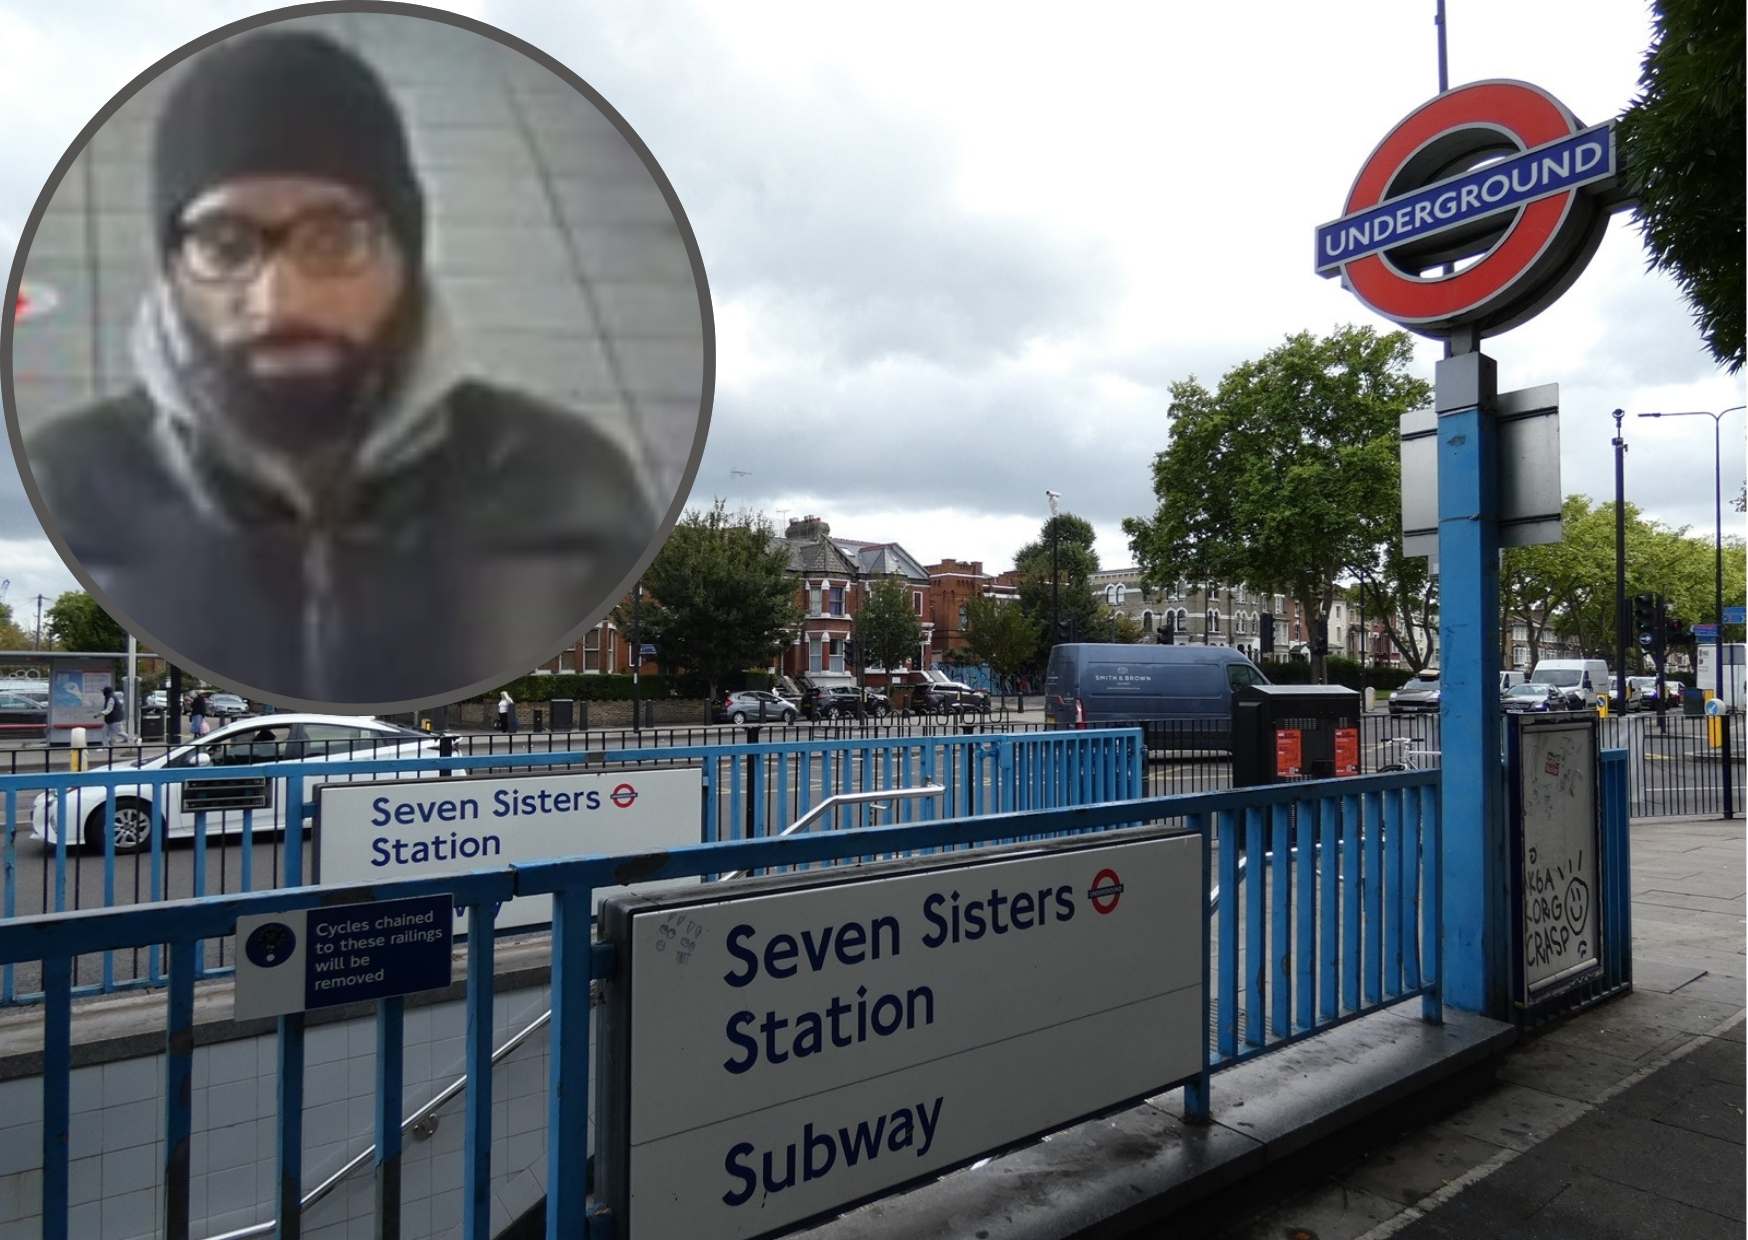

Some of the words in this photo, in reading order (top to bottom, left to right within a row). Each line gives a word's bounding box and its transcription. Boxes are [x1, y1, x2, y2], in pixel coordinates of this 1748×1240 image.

[1325, 142, 1603, 257] UNDERGROUND
[371, 796, 479, 827] Seven
[492, 788, 601, 818] Sisters
[370, 831, 501, 867] Station
[316, 920, 370, 938] Cycles
[375, 910, 434, 929] chained
[316, 943, 334, 954] to
[340, 937, 385, 951] these
[390, 928, 443, 944] railings
[723, 915, 901, 988] Seven
[922, 884, 1076, 949] Sisters
[315, 957, 345, 972] will
[350, 955, 370, 968] be
[315, 968, 385, 991] removed
[722, 984, 935, 1075] Station
[722, 1096, 944, 1207] Subway
